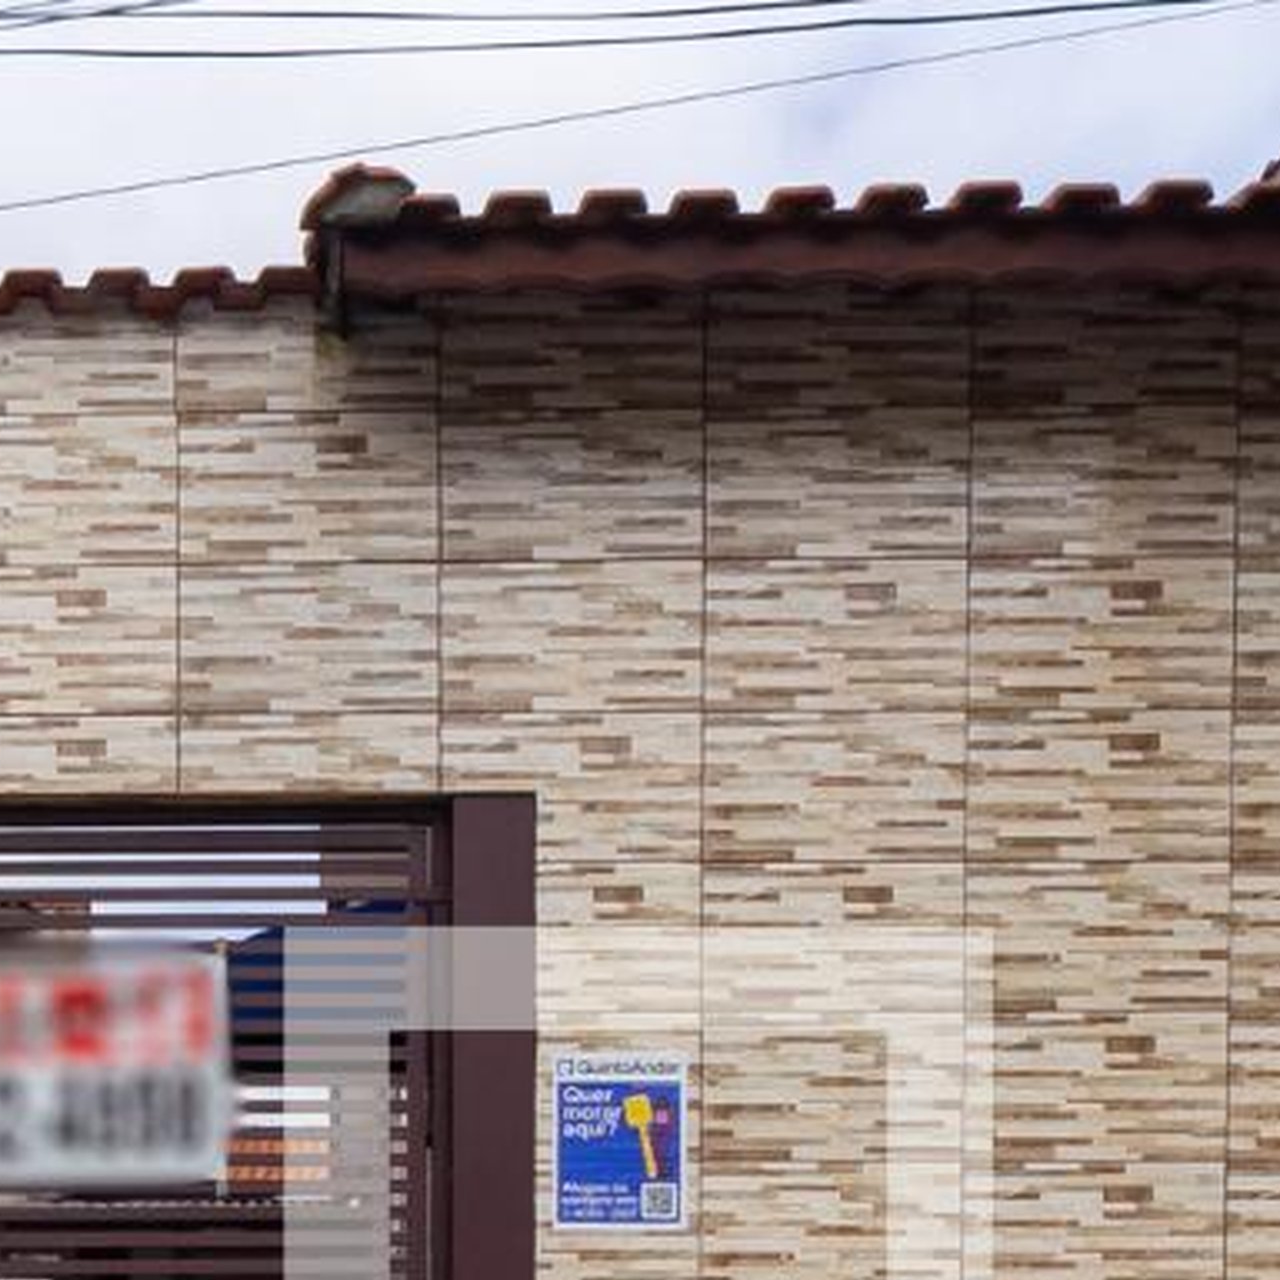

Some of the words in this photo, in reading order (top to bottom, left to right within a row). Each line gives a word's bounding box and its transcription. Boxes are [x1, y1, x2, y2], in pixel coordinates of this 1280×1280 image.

[562, 1085, 614, 1103] Quer
[562, 1106, 622, 1121] morar
[562, 1121, 618, 1139] aqui?
